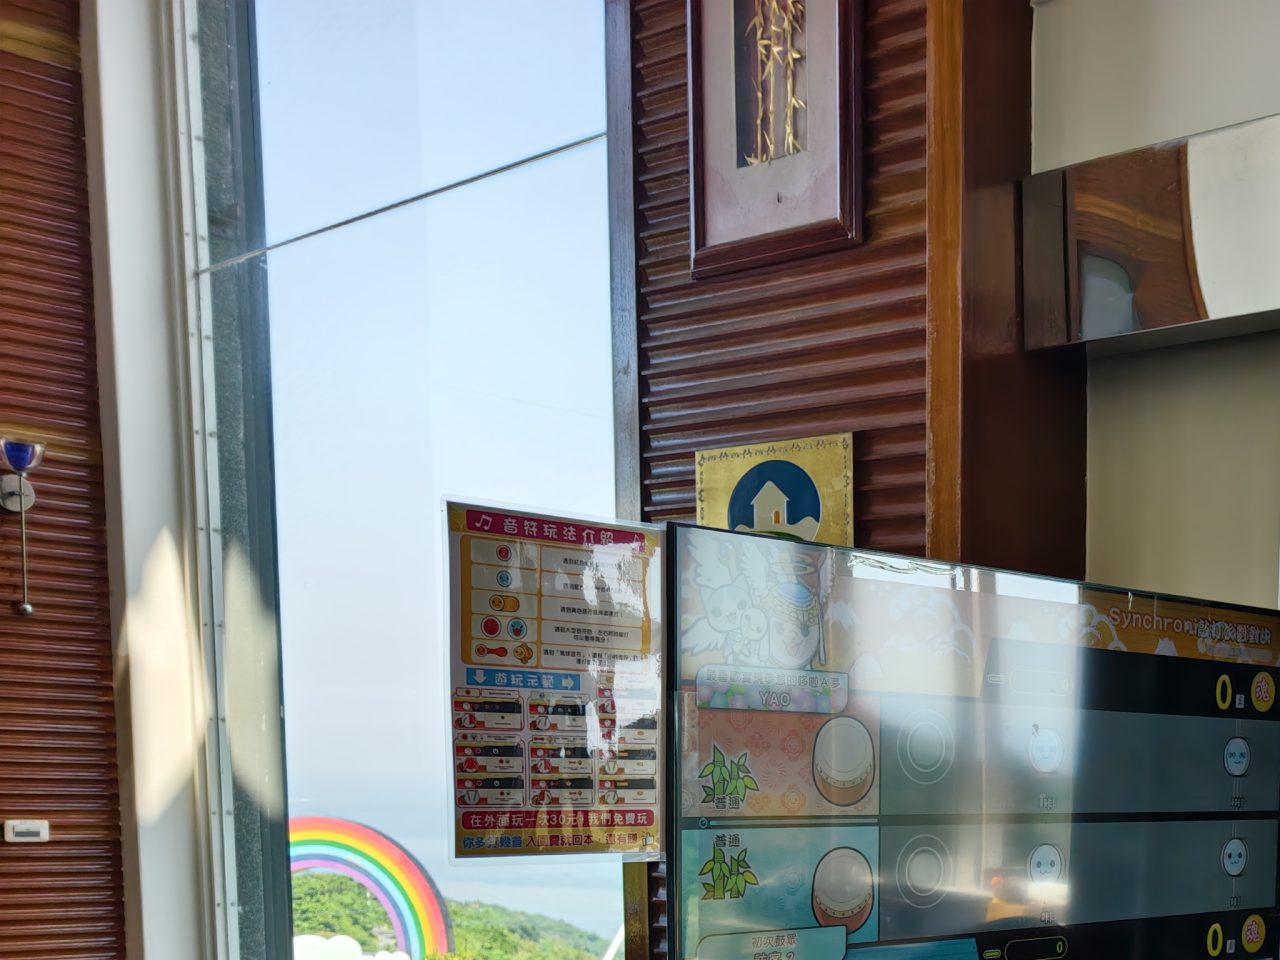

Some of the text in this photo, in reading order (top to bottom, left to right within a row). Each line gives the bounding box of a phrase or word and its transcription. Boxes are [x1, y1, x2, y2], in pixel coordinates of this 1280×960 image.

[759, 691, 792, 706] YAO
[714, 797, 741, 810] 普通
[714, 834, 741, 848] 普通
